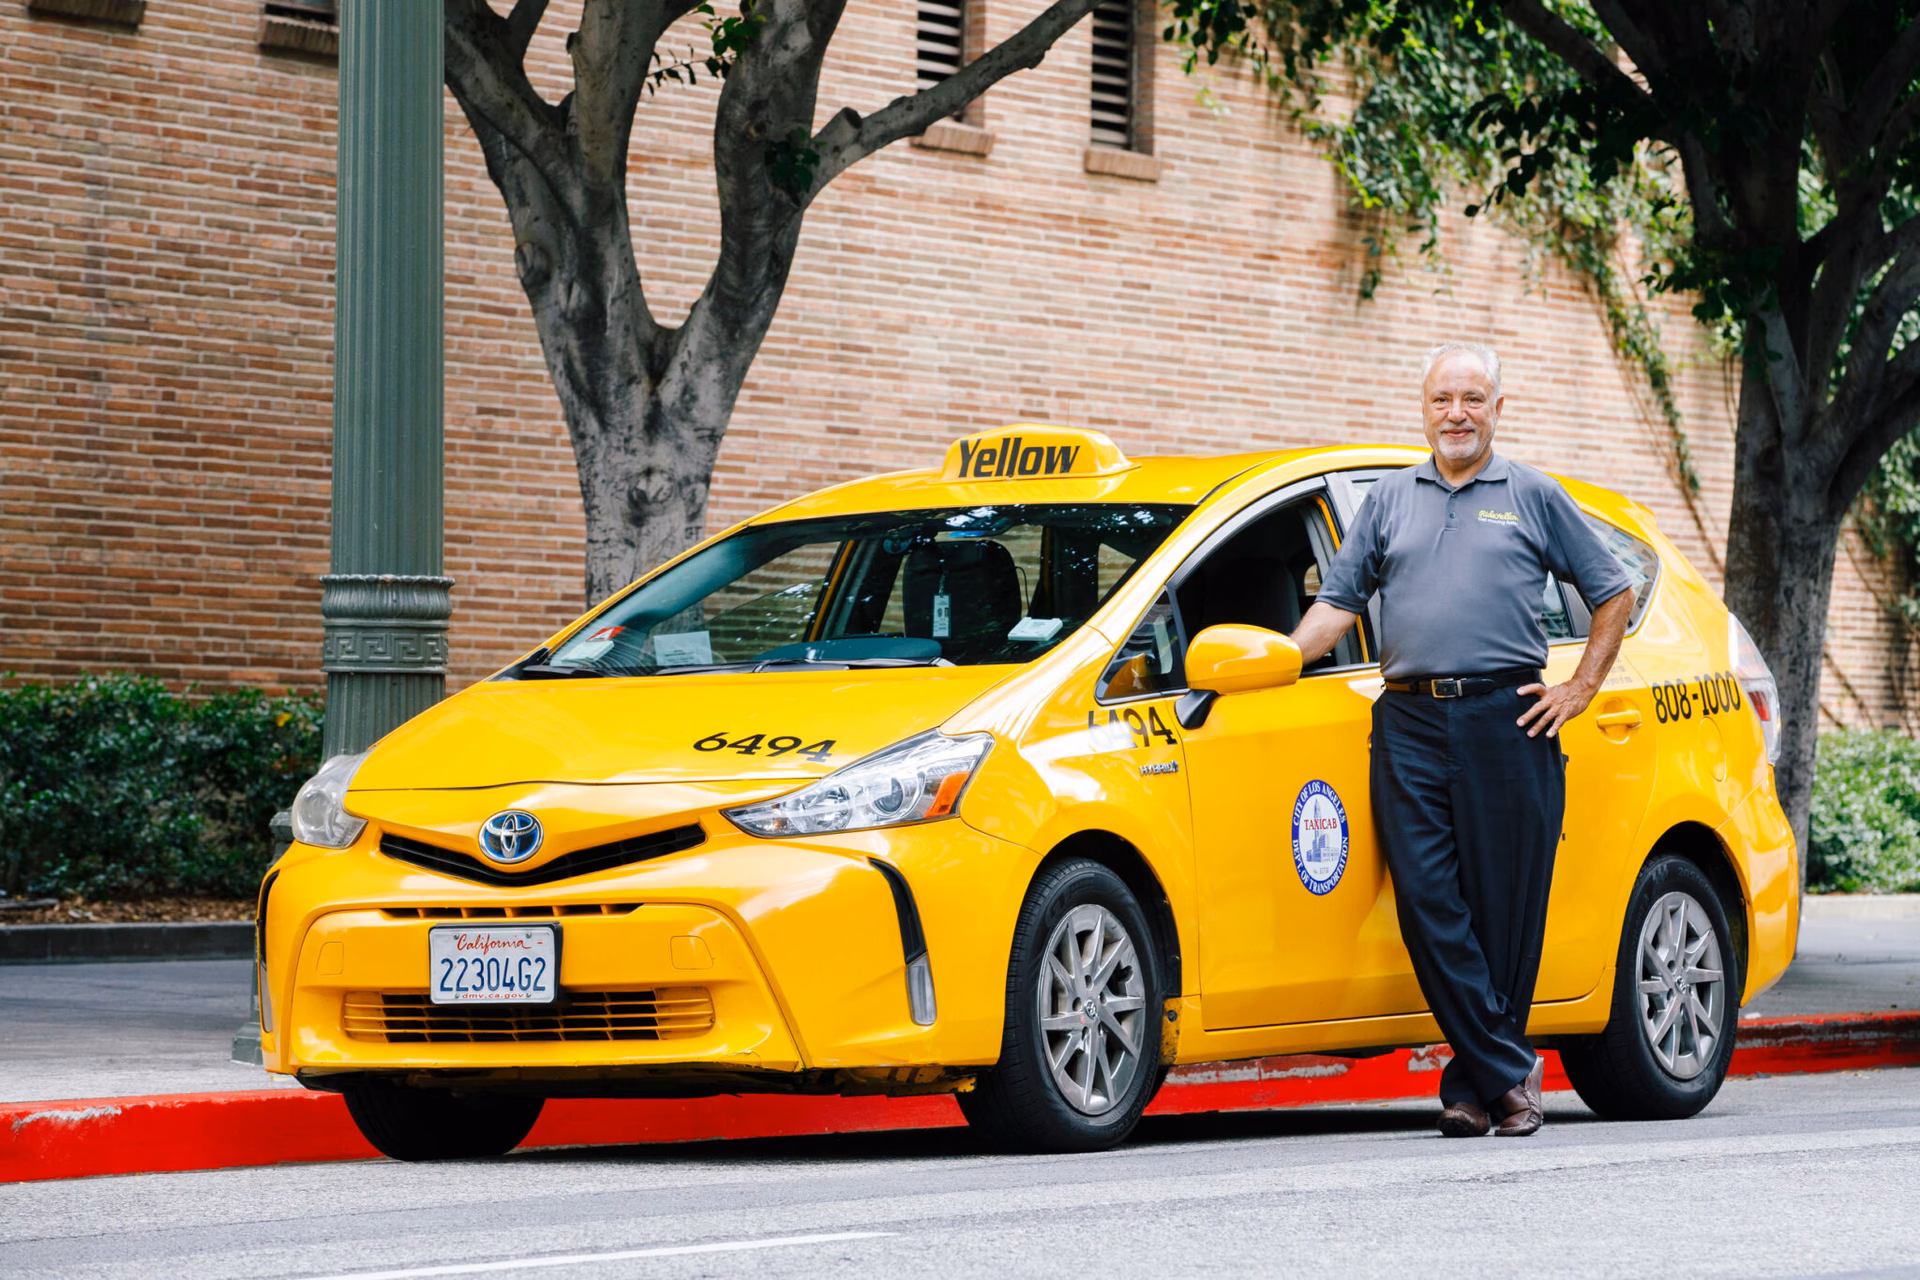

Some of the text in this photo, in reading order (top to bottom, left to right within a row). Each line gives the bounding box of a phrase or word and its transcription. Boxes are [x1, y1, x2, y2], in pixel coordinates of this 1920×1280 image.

[958, 437, 1080, 478] Yellow
[1652, 670, 1741, 724] 808-1000
[693, 732, 837, 763] 6494
[1139, 763, 1174, 775] HYBRID
[1293, 781, 1347, 826] CITY OF LOS ANGELES
[1304, 818, 1338, 831] TAXICAB
[1301, 872, 1310, 885] OF
[1308, 836, 1348, 894] TRANSPORTATION
[457, 934, 531, 955] California
[440, 957, 546, 992] 22304G2
